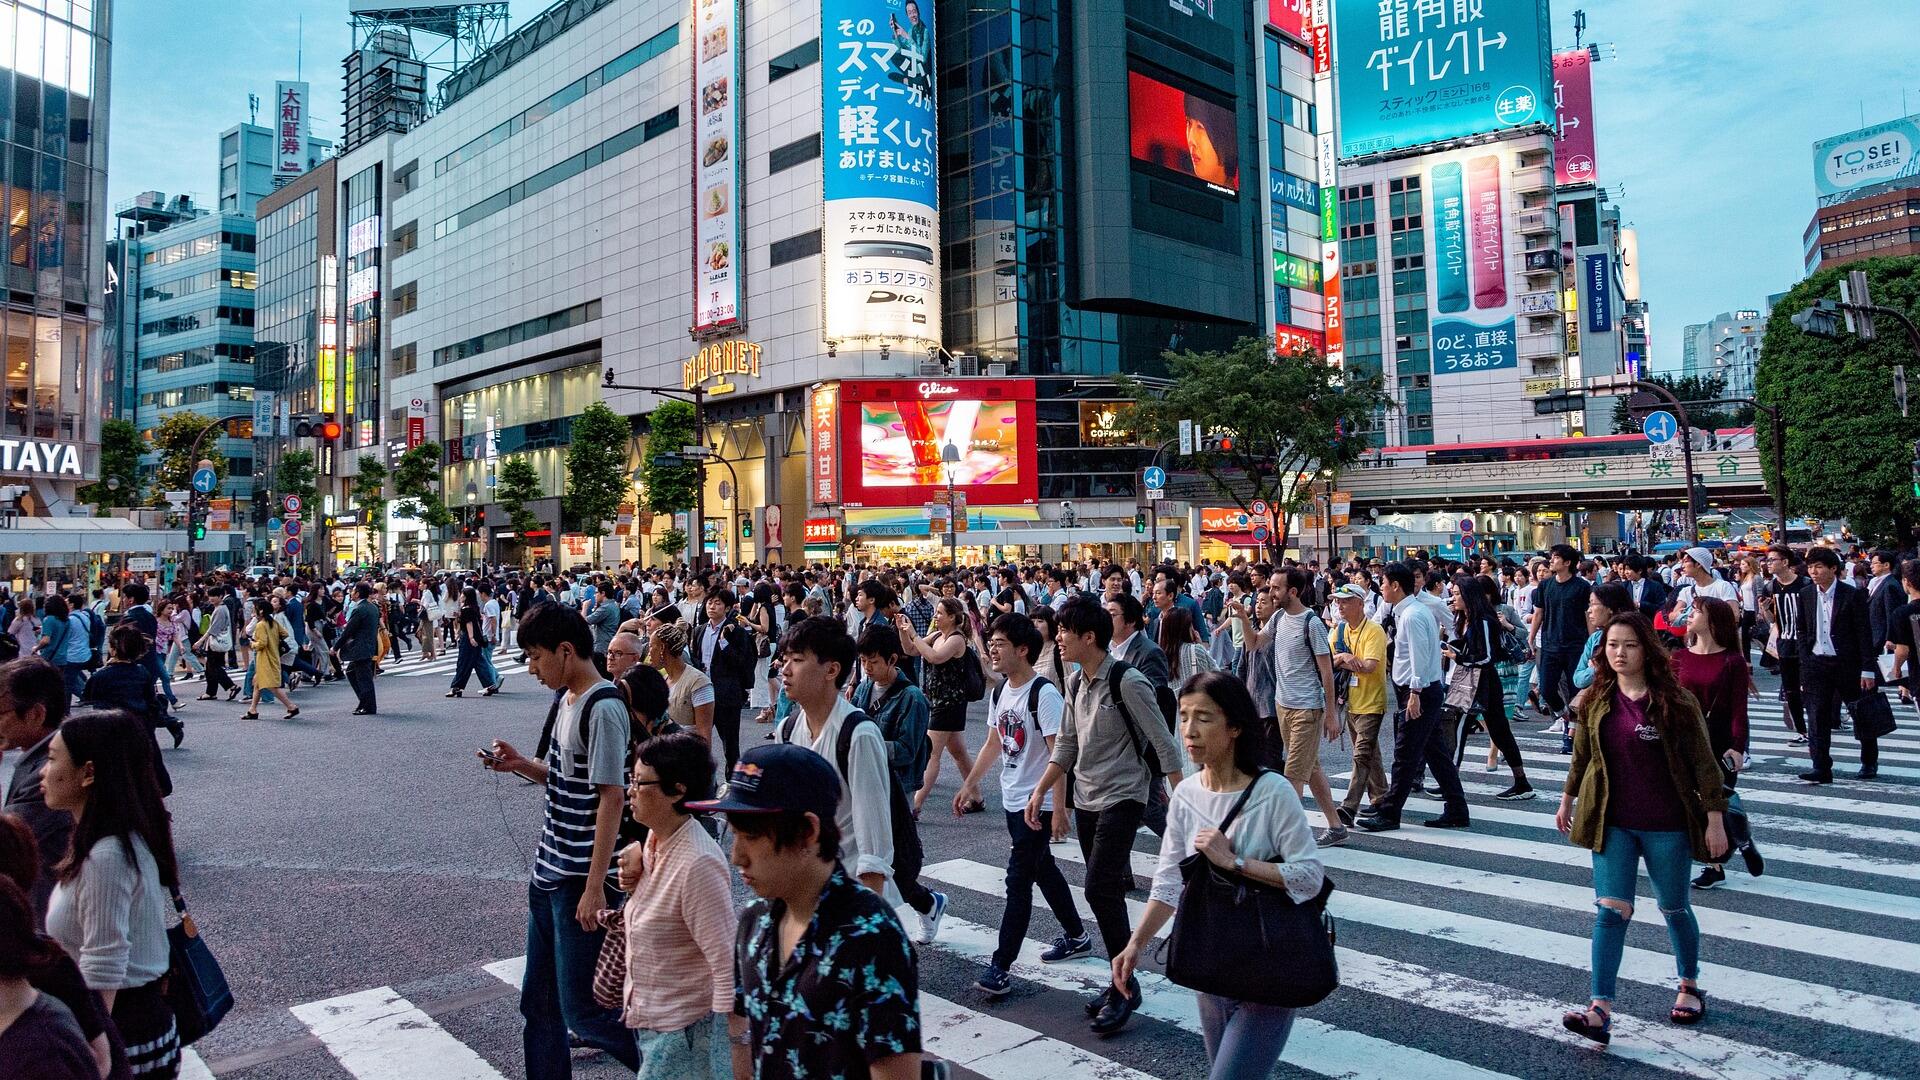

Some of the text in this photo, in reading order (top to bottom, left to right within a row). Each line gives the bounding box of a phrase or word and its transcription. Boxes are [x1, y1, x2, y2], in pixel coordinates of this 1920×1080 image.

[837, 18, 875, 37] その
[1317, 37, 1328, 72] アイフル
[1366, 27, 1508, 91] ダイレクト
[837, 76, 932, 112] ディーガが
[1379, 90, 1438, 112] スティック
[1442, 87, 1467, 98] ミント
[1498, 94, 1533, 115] 生薬
[281, 88, 301, 155] 大和証券
[838, 105, 933, 154] 軽くして
[1322, 136, 1332, 185] レオパレス21
[1568, 161, 1592, 174] 生薬
[1833, 140, 1900, 168] TOSEI
[1271, 177, 1316, 207] レオパレス21
[849, 211, 932, 228] スマホの写真や動画は
[1480, 190, 1498, 272] 龍角散ダイレクト
[1443, 196, 1463, 276] 龍角散ダイレクト
[846, 270, 934, 290] おうちクラウド
[866, 290, 925, 304] DIGA
[1327, 296, 1339, 329] アコム
[1437, 330, 1515, 351] のど、直接、
[683, 340, 762, 390] MAGNET
[1444, 351, 1503, 369] うるおう
[918, 382, 959, 398] Glico
[0, 439, 81, 475] TAYA
[817, 407, 832, 500] 天津甘栗
[1585, 462, 1607, 475] JR
[806, 525, 836, 537] 天津甘栗
[876, 545, 917, 553] TAX Free
